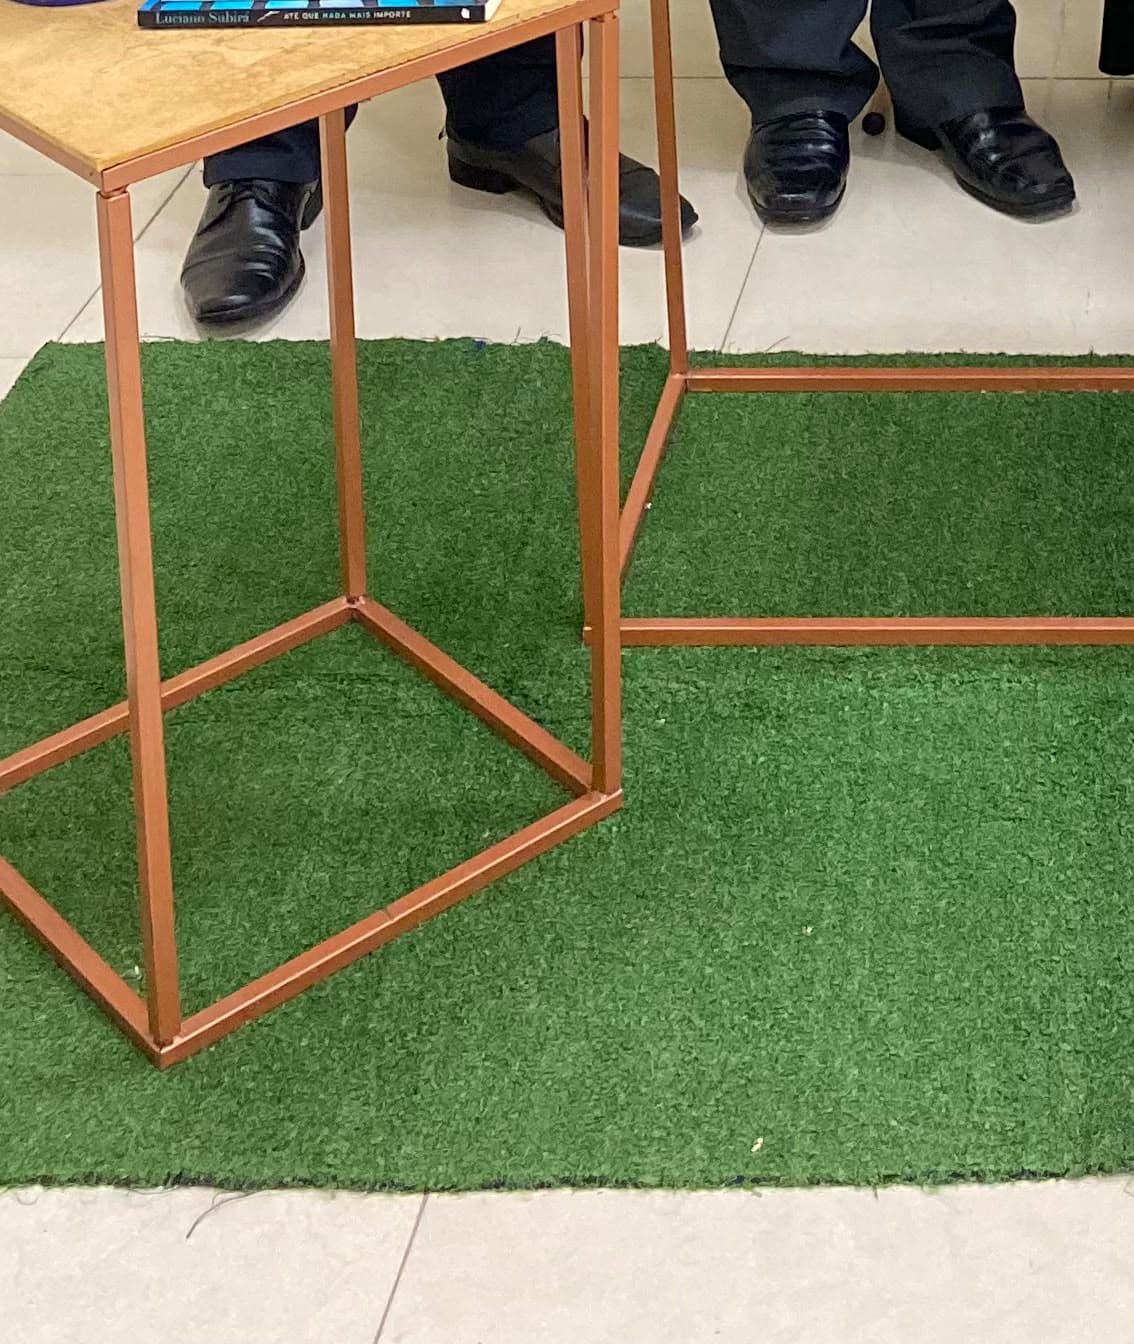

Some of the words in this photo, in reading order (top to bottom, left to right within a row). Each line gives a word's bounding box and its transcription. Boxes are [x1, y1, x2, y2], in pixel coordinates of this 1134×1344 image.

[155, 12, 205, 25] Luciano
[208, 10, 249, 24] Subirá
[302, 11, 319, 20] QUE
[322, 11, 346, 20] NADA
[349, 10, 370, 19] MAIS
[373, 10, 411, 19] IMPORTE
